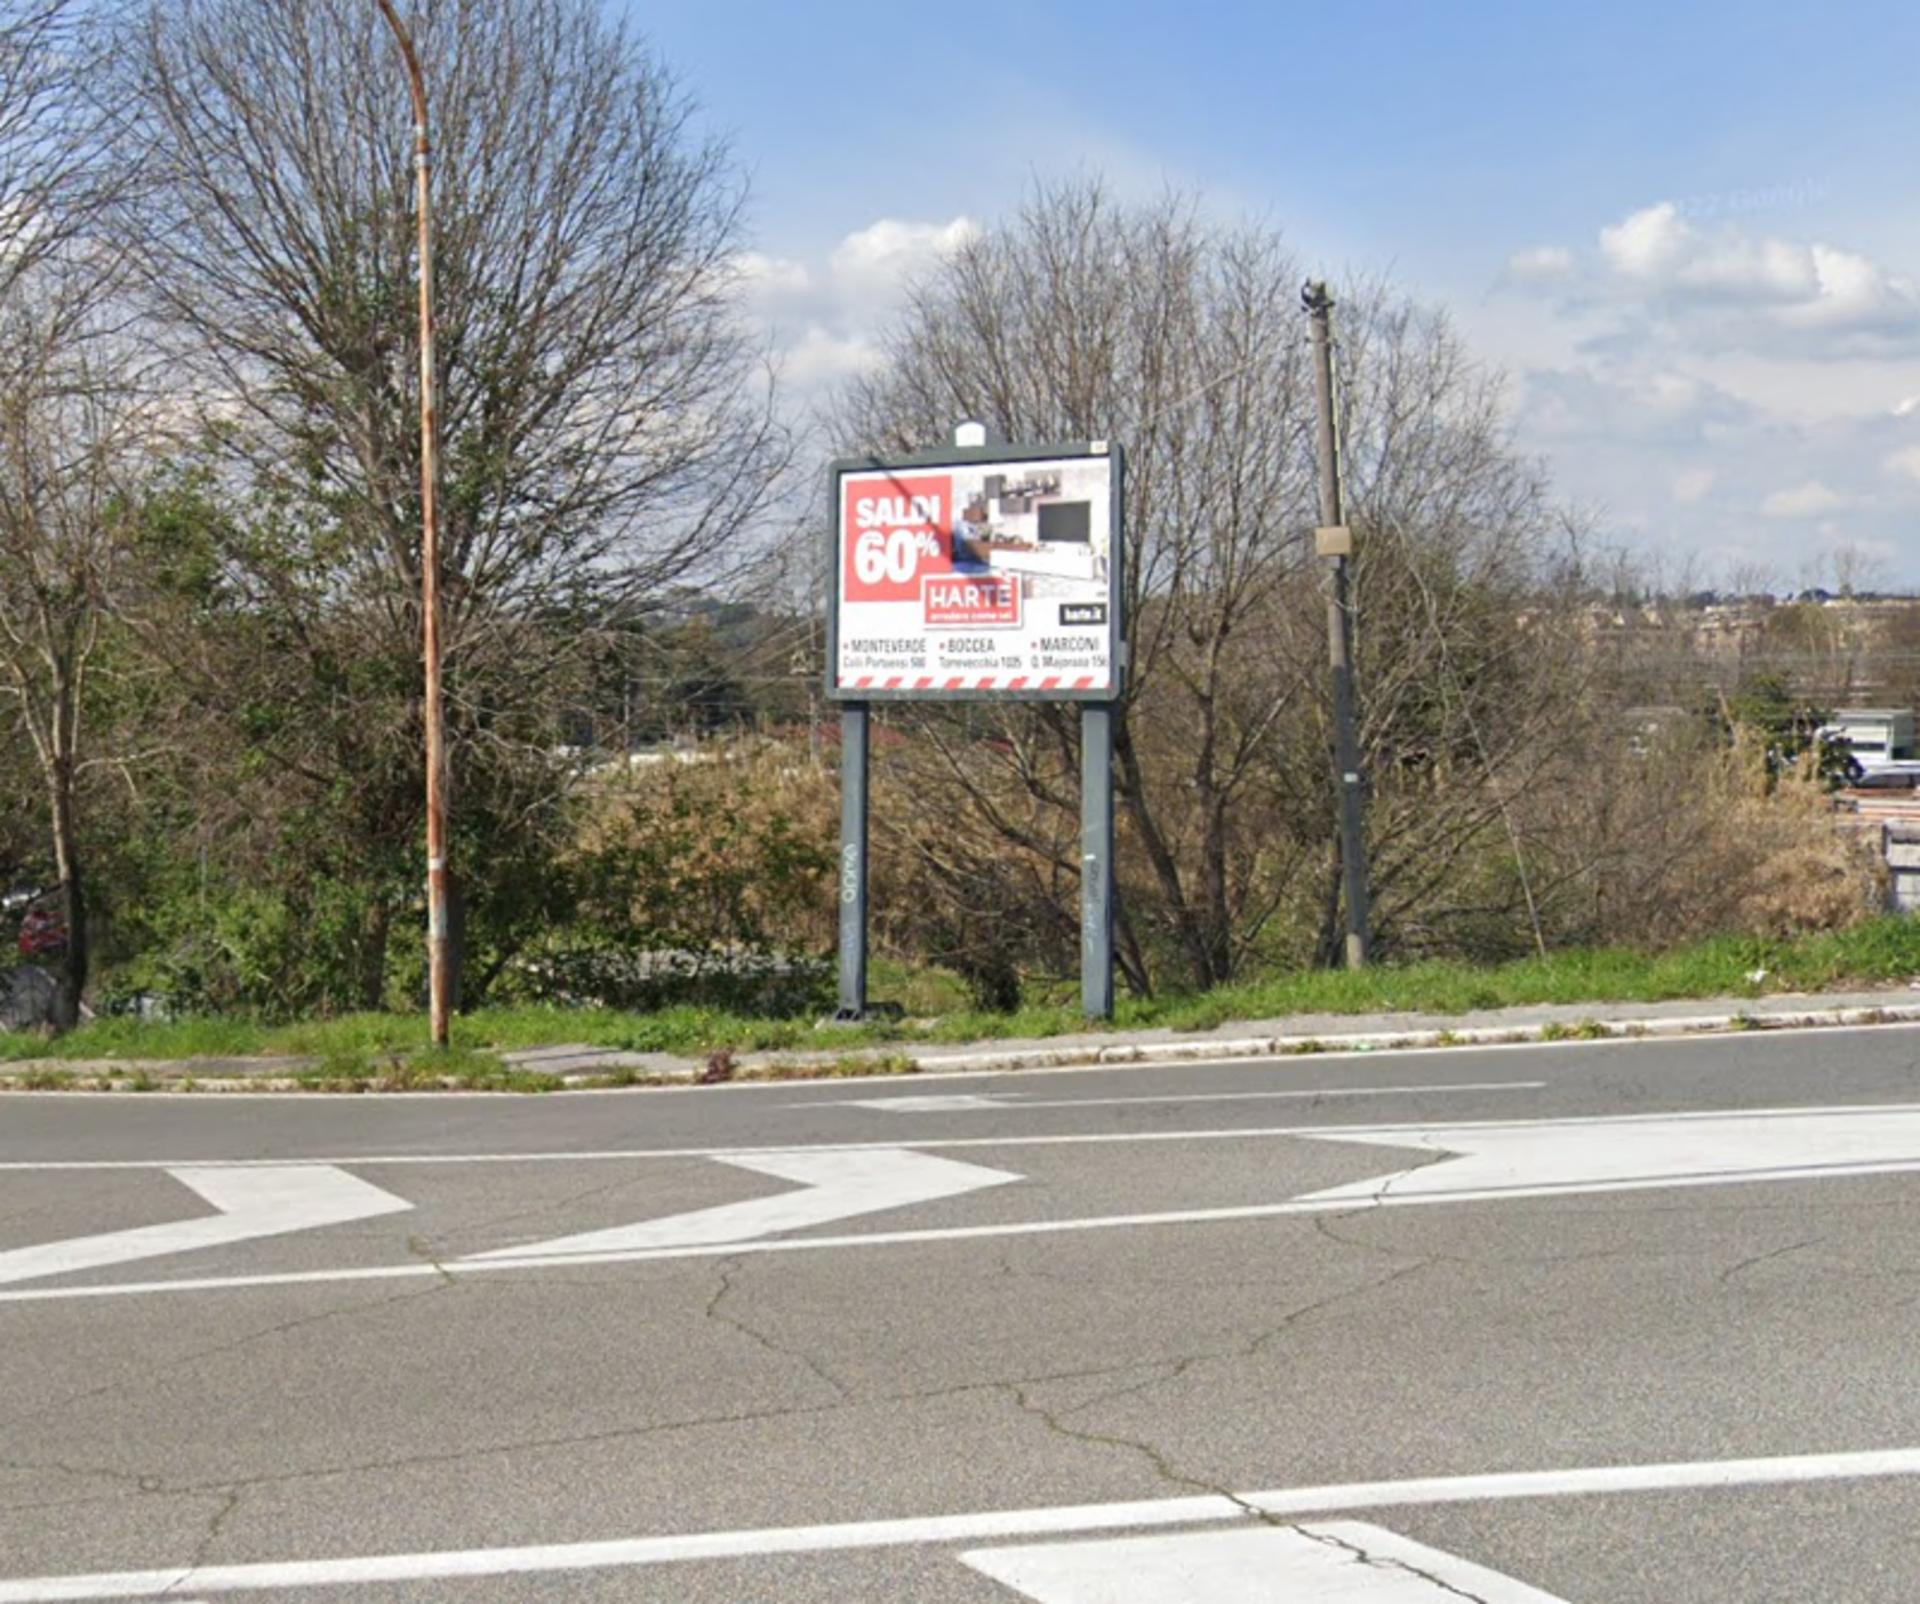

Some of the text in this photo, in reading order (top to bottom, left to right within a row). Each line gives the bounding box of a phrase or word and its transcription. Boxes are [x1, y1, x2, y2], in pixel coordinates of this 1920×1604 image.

[855, 495, 941, 527] SALDI
[855, 530, 941, 585] 60%
[851, 638, 927, 653] MONTEVERDE
[948, 637, 995, 653] BOCCEA
[1040, 636, 1099, 652] MARCONI
